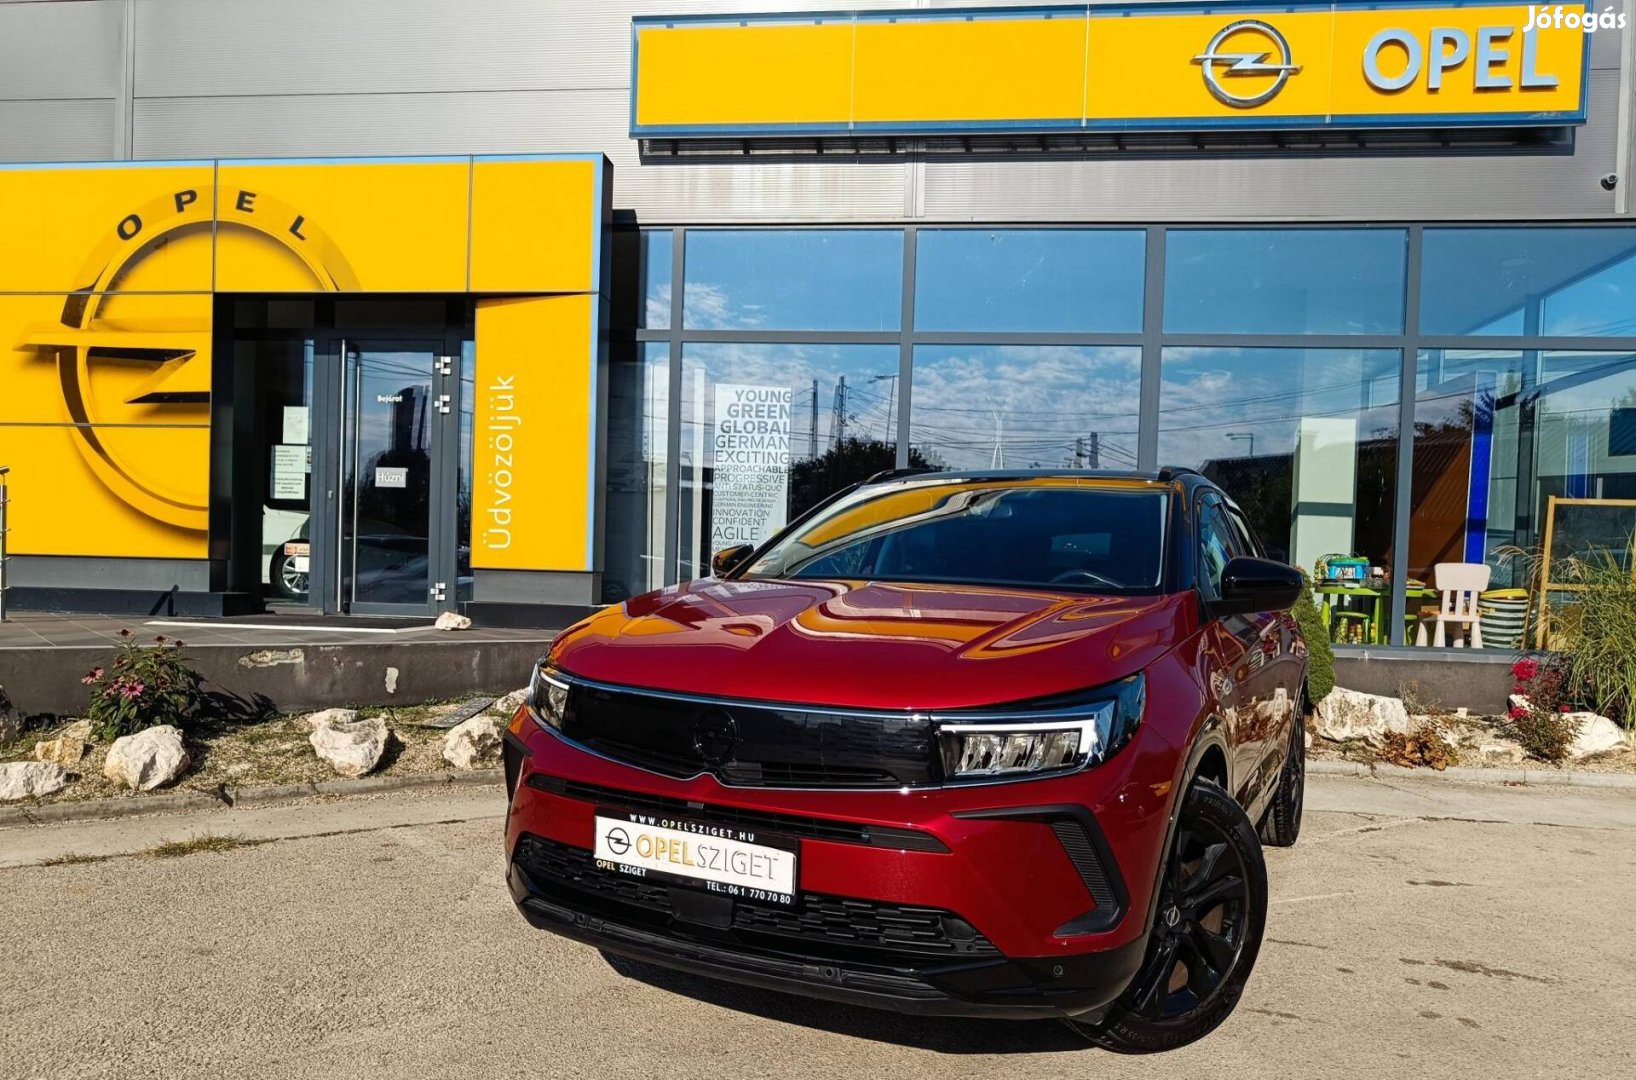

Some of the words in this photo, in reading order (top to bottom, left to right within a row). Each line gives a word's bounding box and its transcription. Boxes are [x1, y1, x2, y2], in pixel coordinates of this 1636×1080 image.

[1363, 26, 1559, 92] OPEL
[117, 189, 306, 241] OPEL
[735, 389, 792, 404] YOUNG
[727, 403, 791, 419] GREEN
[720, 420, 790, 435] GLOBAL
[715, 434, 790, 450] GERMAN
[482, 375, 522, 549] Üdvözöljük
[715, 450, 790, 465] EXCITING
[714, 464, 790, 474] APPROACHABLE
[376, 471, 405, 483] Húzni
[714, 473, 785, 484] PROGRESSIVE
[713, 508, 771, 518] INNOVATION
[712, 517, 767, 526] CONFIDENT
[712, 526, 759, 541] AGILE
[629, 813, 755, 842] WWW.OPELSZIGET.HU
[635, 833, 780, 880] OPELSZIGET
[596, 859, 616, 871] OPEL
[619, 864, 647, 877] SZIGET
[728, 885, 739, 896] 06
[750, 888, 765, 900] 770
[767, 891, 778, 902] 70
[780, 893, 791, 904] 80
